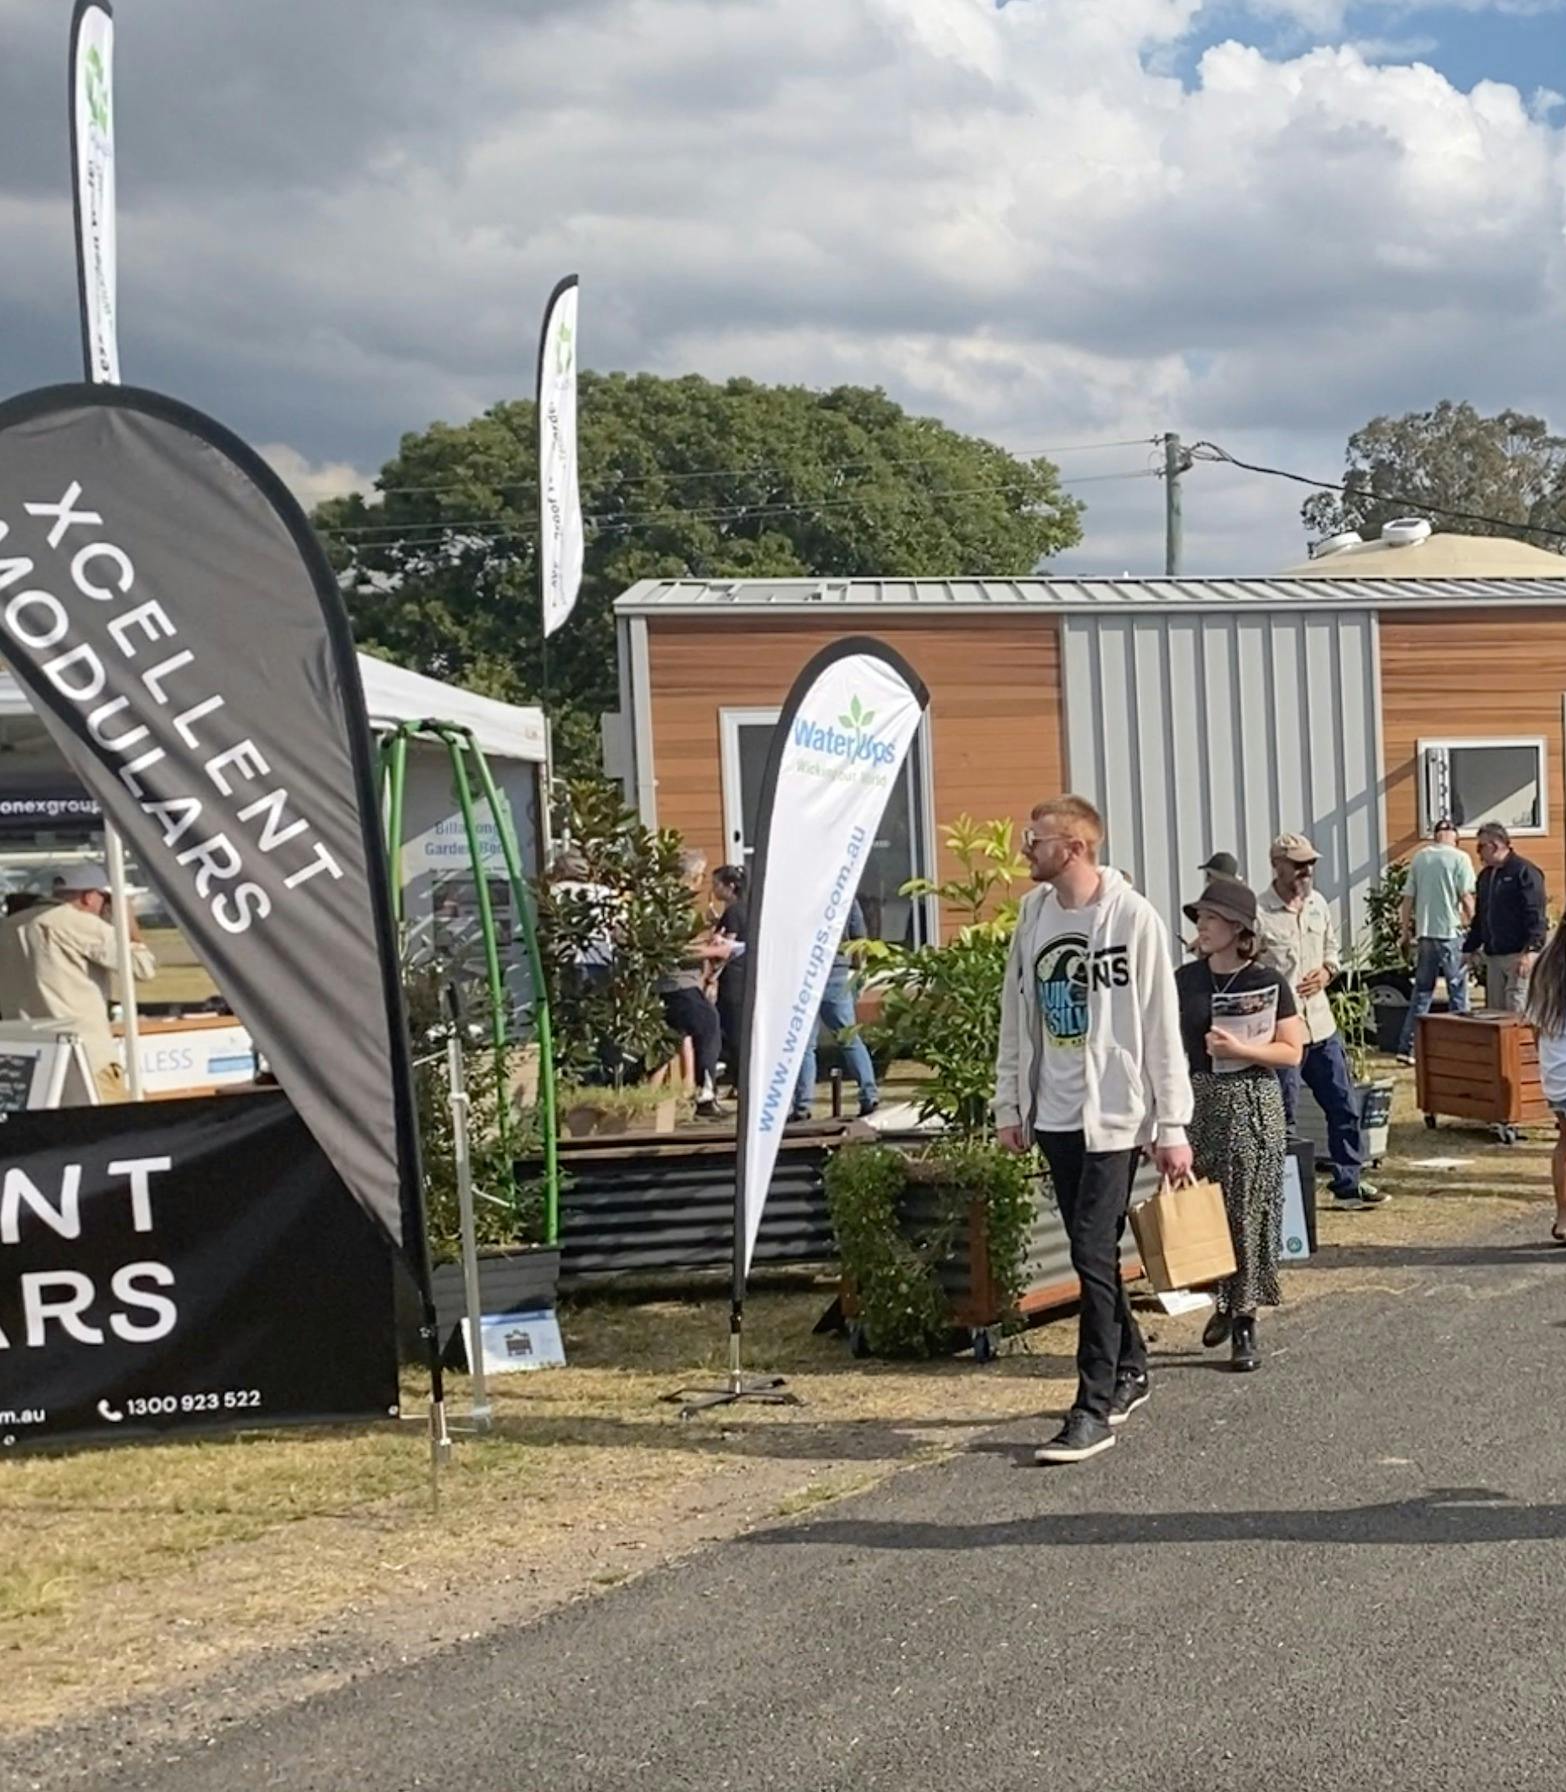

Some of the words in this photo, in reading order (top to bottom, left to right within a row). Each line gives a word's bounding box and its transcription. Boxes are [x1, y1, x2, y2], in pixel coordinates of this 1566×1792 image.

[22, 480, 344, 889] XCELLENT
[794, 717, 896, 769] WaterUps
[425, 842, 471, 856] Garde
[758, 825, 866, 1132] www.waterups.com.au
[141, 1048, 194, 1073] LESS
[0, 1261, 177, 1348] RS
[127, 1396, 177, 1415] 1300
[181, 1394, 220, 1412] 923
[224, 1390, 261, 1408] 522
